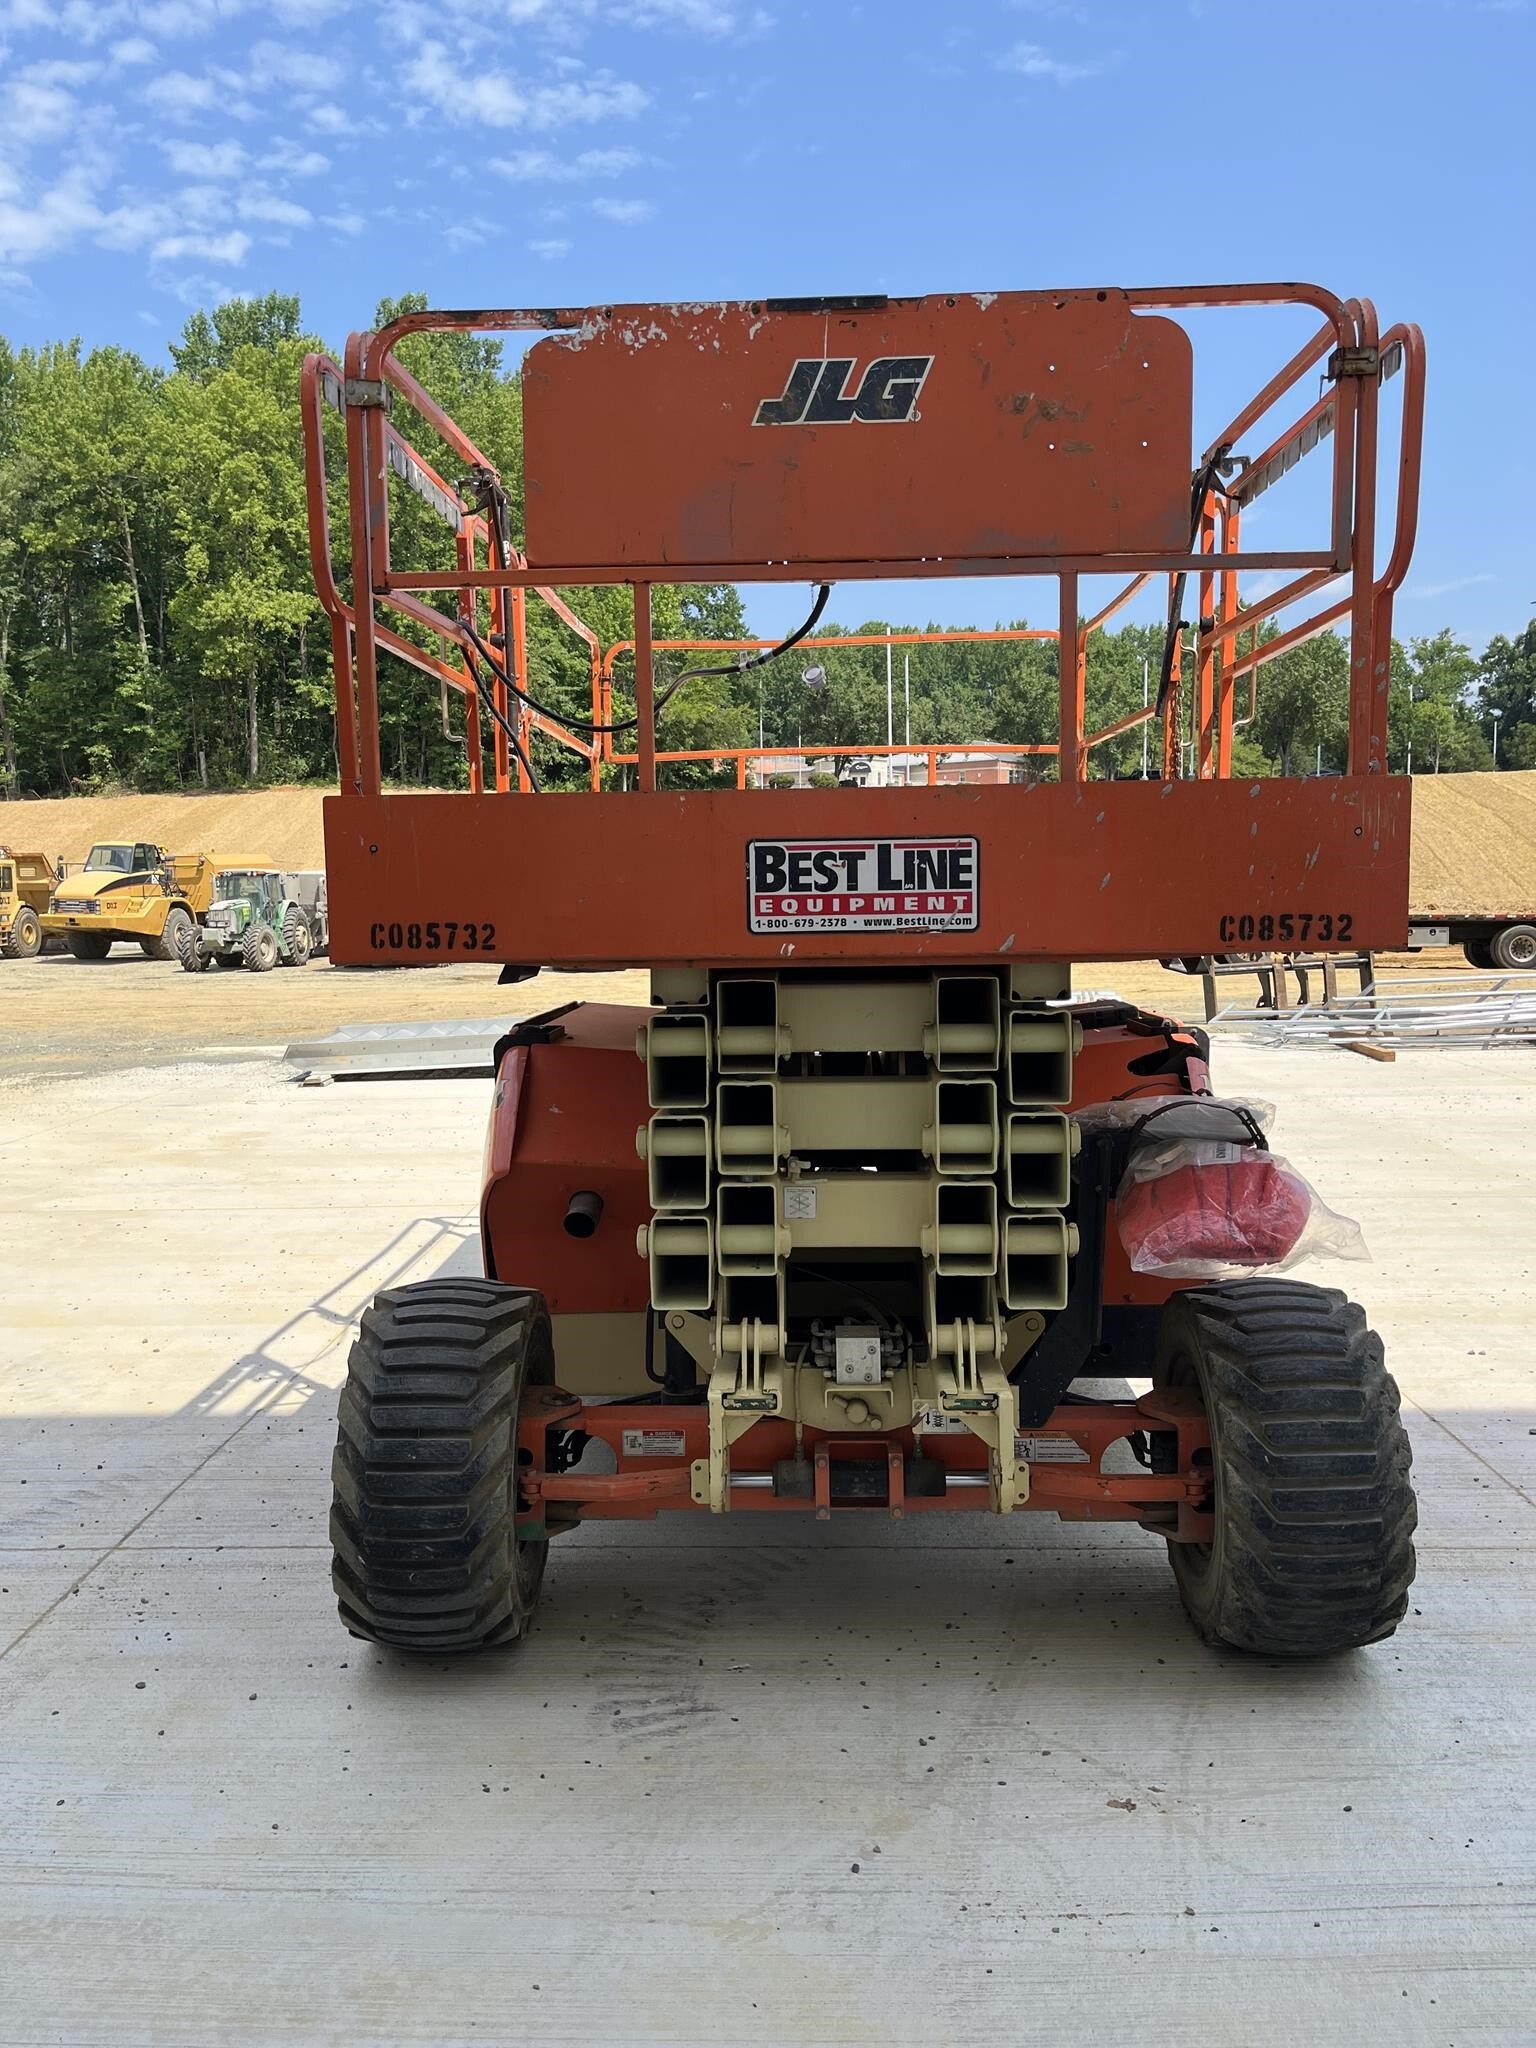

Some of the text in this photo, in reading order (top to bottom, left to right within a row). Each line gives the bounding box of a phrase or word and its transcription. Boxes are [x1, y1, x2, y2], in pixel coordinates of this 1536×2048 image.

[752, 355, 935, 426] JLG
[754, 844, 973, 893] BEST LINE
[759, 895, 968, 914] EQUIPMENT
[370, 922, 497, 950] C085732
[755, 915, 972, 929] 1-800-679-2378 www.BestLinecom
[1219, 913, 1353, 942] C085732
